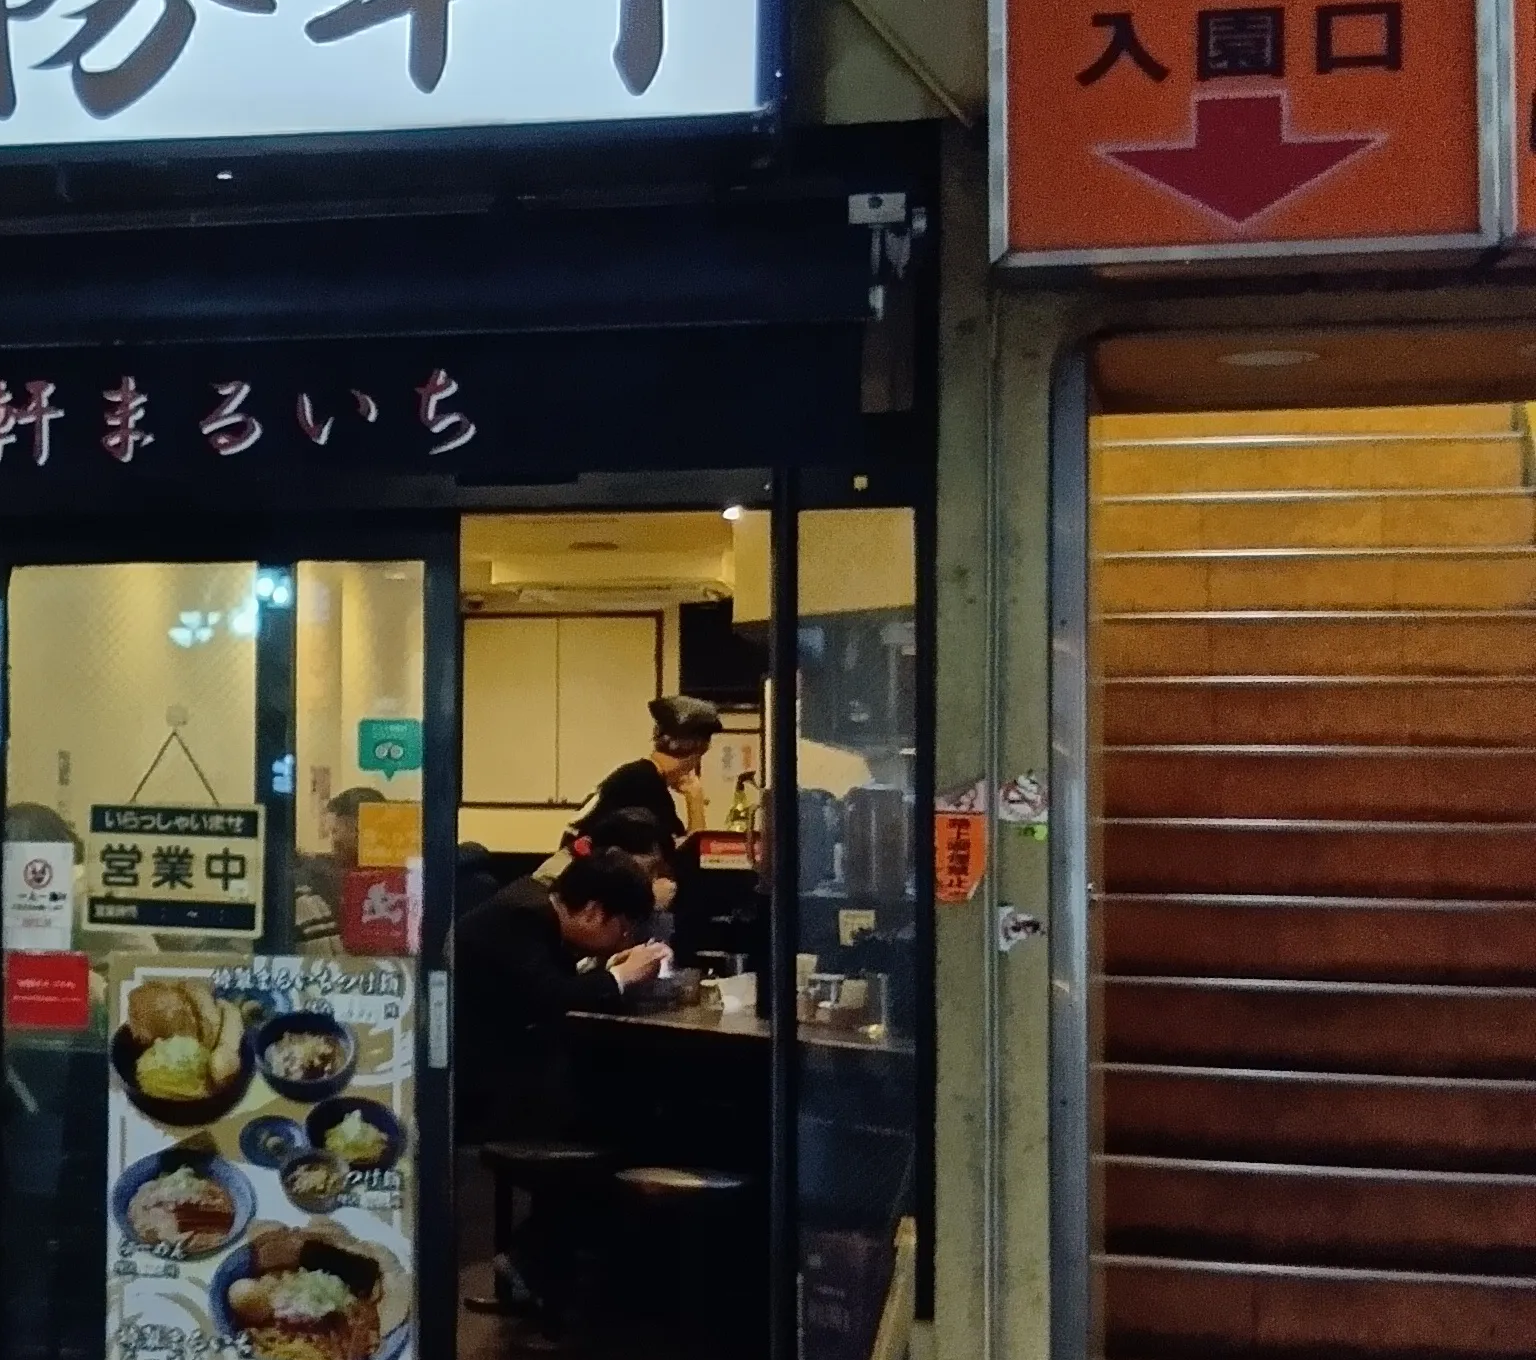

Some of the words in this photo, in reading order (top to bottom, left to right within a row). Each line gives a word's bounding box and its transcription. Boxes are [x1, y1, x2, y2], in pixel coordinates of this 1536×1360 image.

[1075, 2, 1402, 86] 入園口
[104, 809, 245, 833] いらっしゃいませ
[99, 843, 247, 892] 営業中
